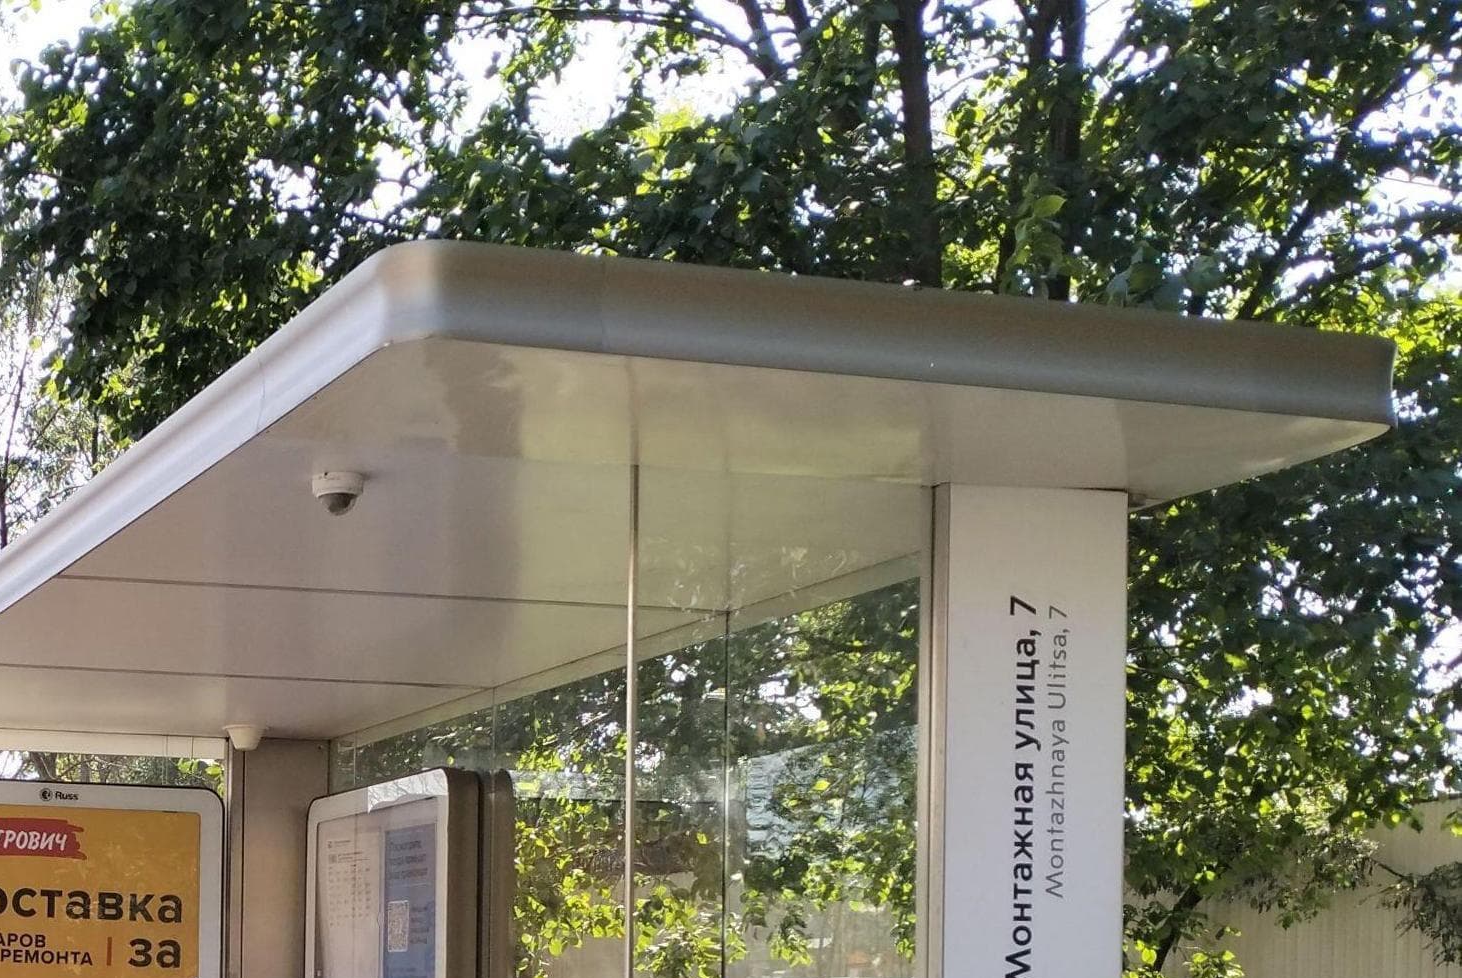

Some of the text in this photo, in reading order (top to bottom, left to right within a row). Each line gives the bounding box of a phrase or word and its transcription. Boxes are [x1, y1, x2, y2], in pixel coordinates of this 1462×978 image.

[1010, 595, 1038, 616] 7
[1015, 628, 1042, 751] улица,
[1045, 605, 1071, 899] Montazhnaya Ulitsa, 7
[55, 790, 79, 800] Russ
[0, 949, 93, 966] РЕМОНТА
[128, 938, 180, 968] за
